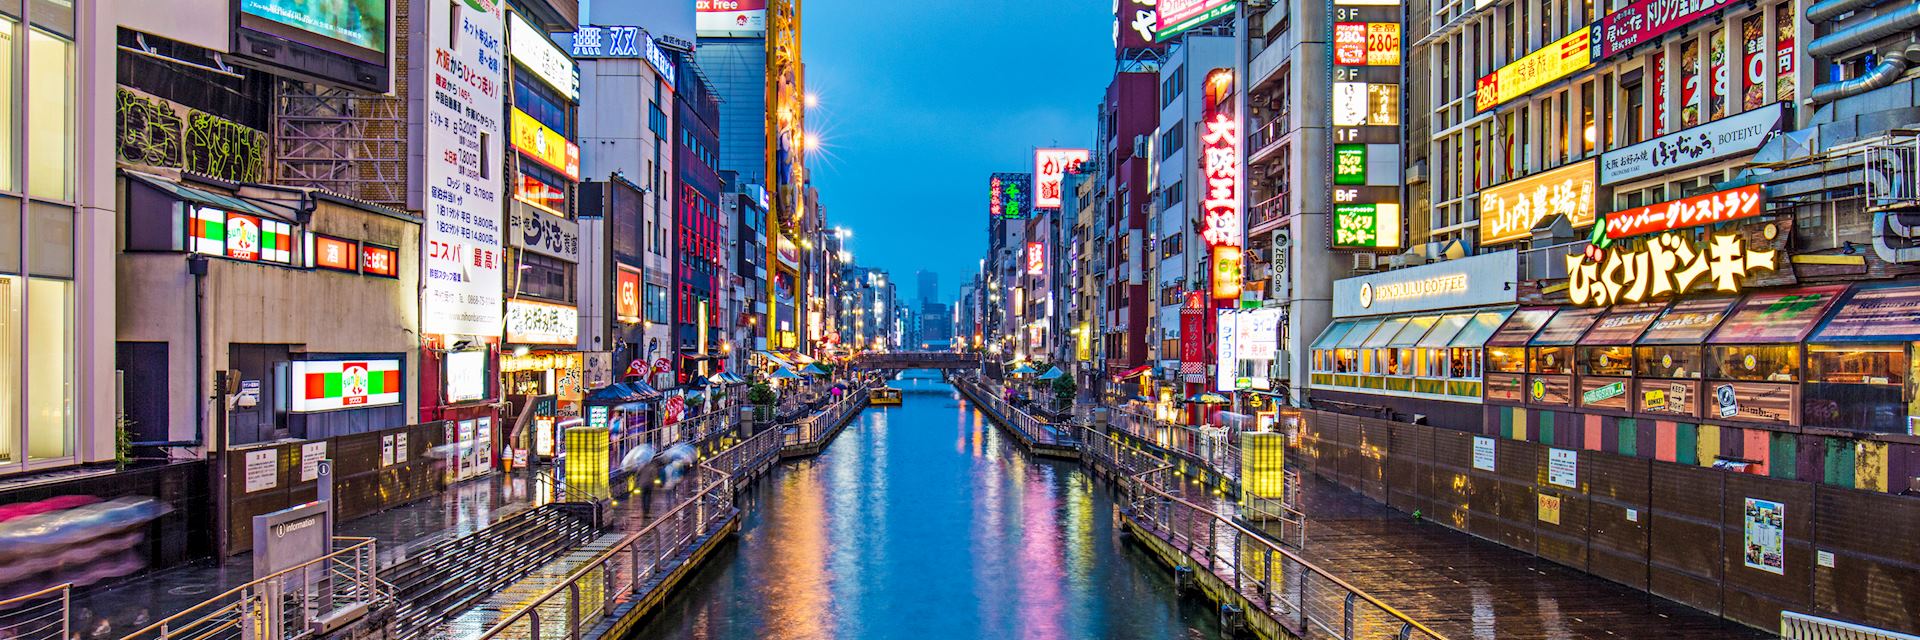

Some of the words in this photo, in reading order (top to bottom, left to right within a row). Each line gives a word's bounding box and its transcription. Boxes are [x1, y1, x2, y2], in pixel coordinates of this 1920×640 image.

[1369, 34, 1399, 51] 280円
[1718, 125, 1762, 146] BOTEJYU
[1606, 191, 1759, 233] ハンバーグレストラン
[326, 243, 339, 264] 酒
[363, 250, 389, 271] たばこ
[1566, 233, 1775, 307] びっくりドンキー
[623, 280, 634, 305] G3
[1375, 278, 1423, 300] HONOLULU
[1423, 274, 1466, 297] COFFEE
[286, 518, 316, 533] information
